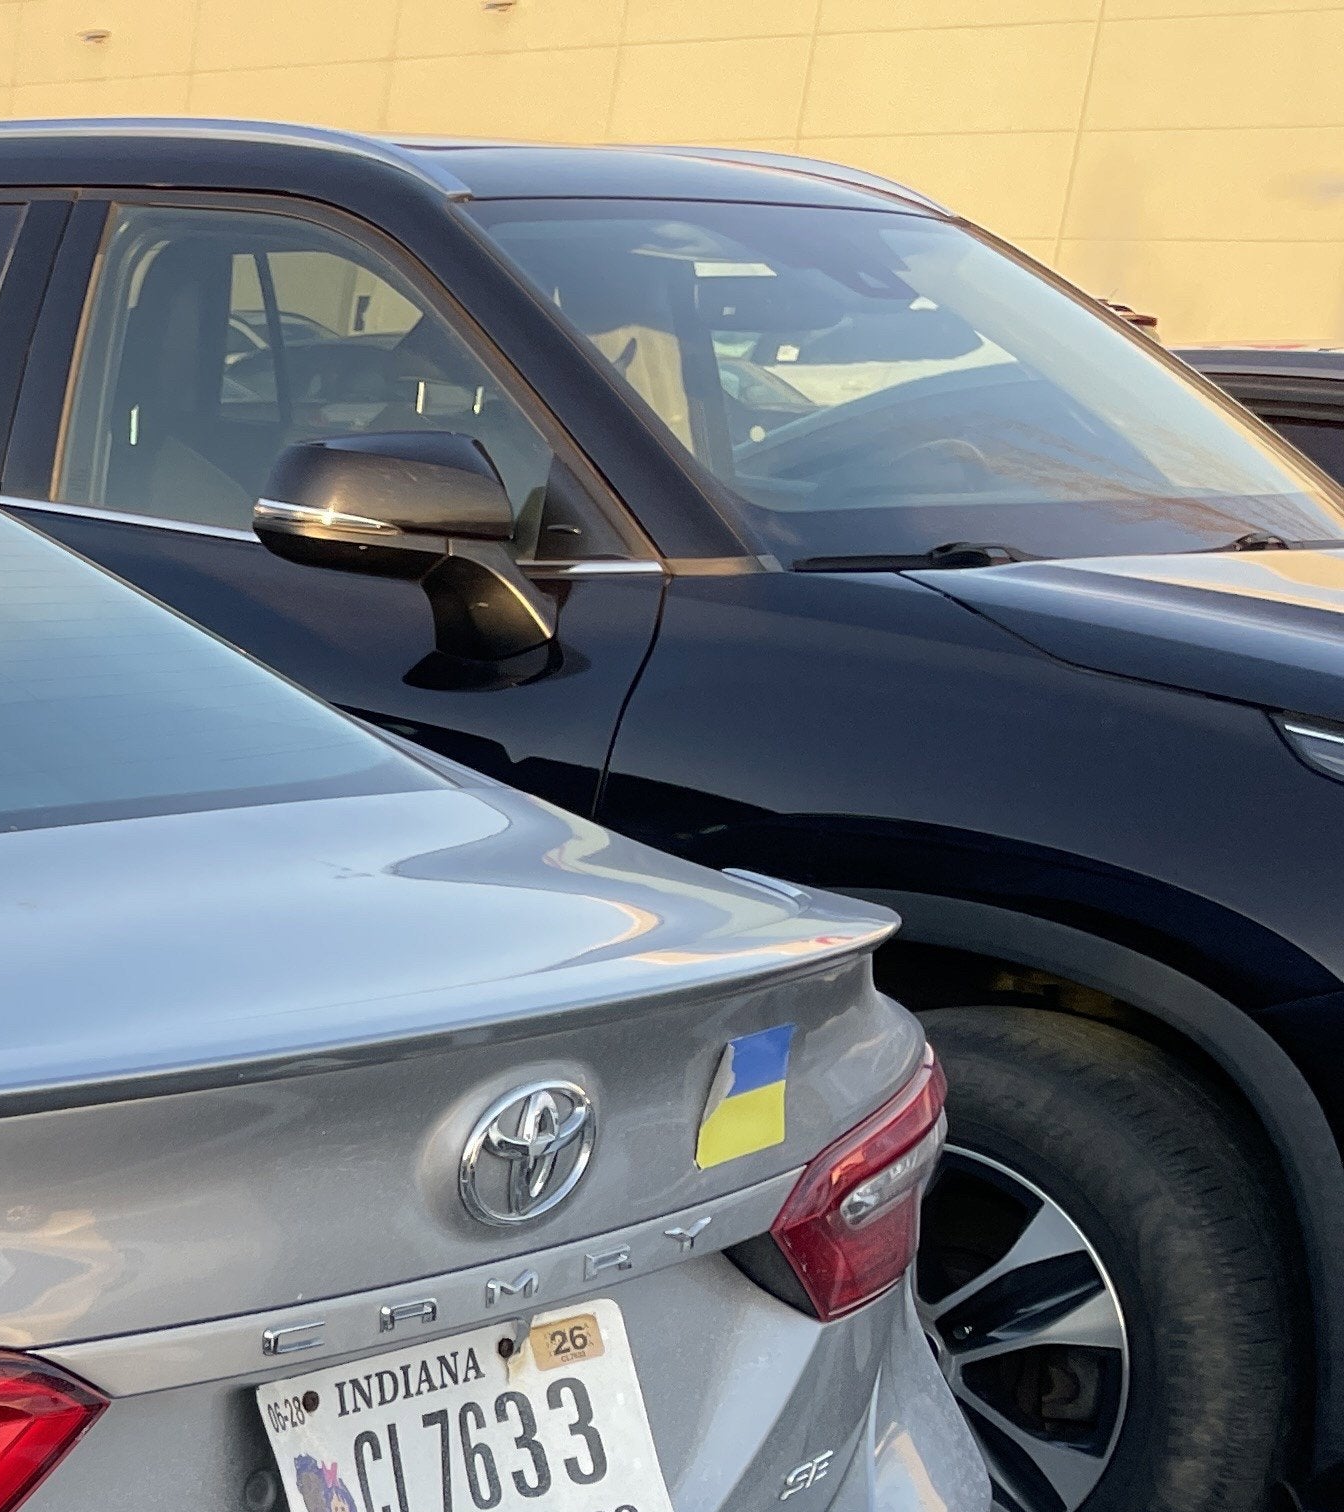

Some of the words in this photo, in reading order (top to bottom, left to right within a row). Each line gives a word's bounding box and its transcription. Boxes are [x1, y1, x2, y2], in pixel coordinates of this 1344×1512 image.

[262, 1216, 712, 1357] CAMRY
[550, 1325, 588, 1356] 26
[334, 1347, 485, 1418] INDIANA
[267, 1395, 305, 1433] 06-28
[778, 1450, 834, 1501] SE
